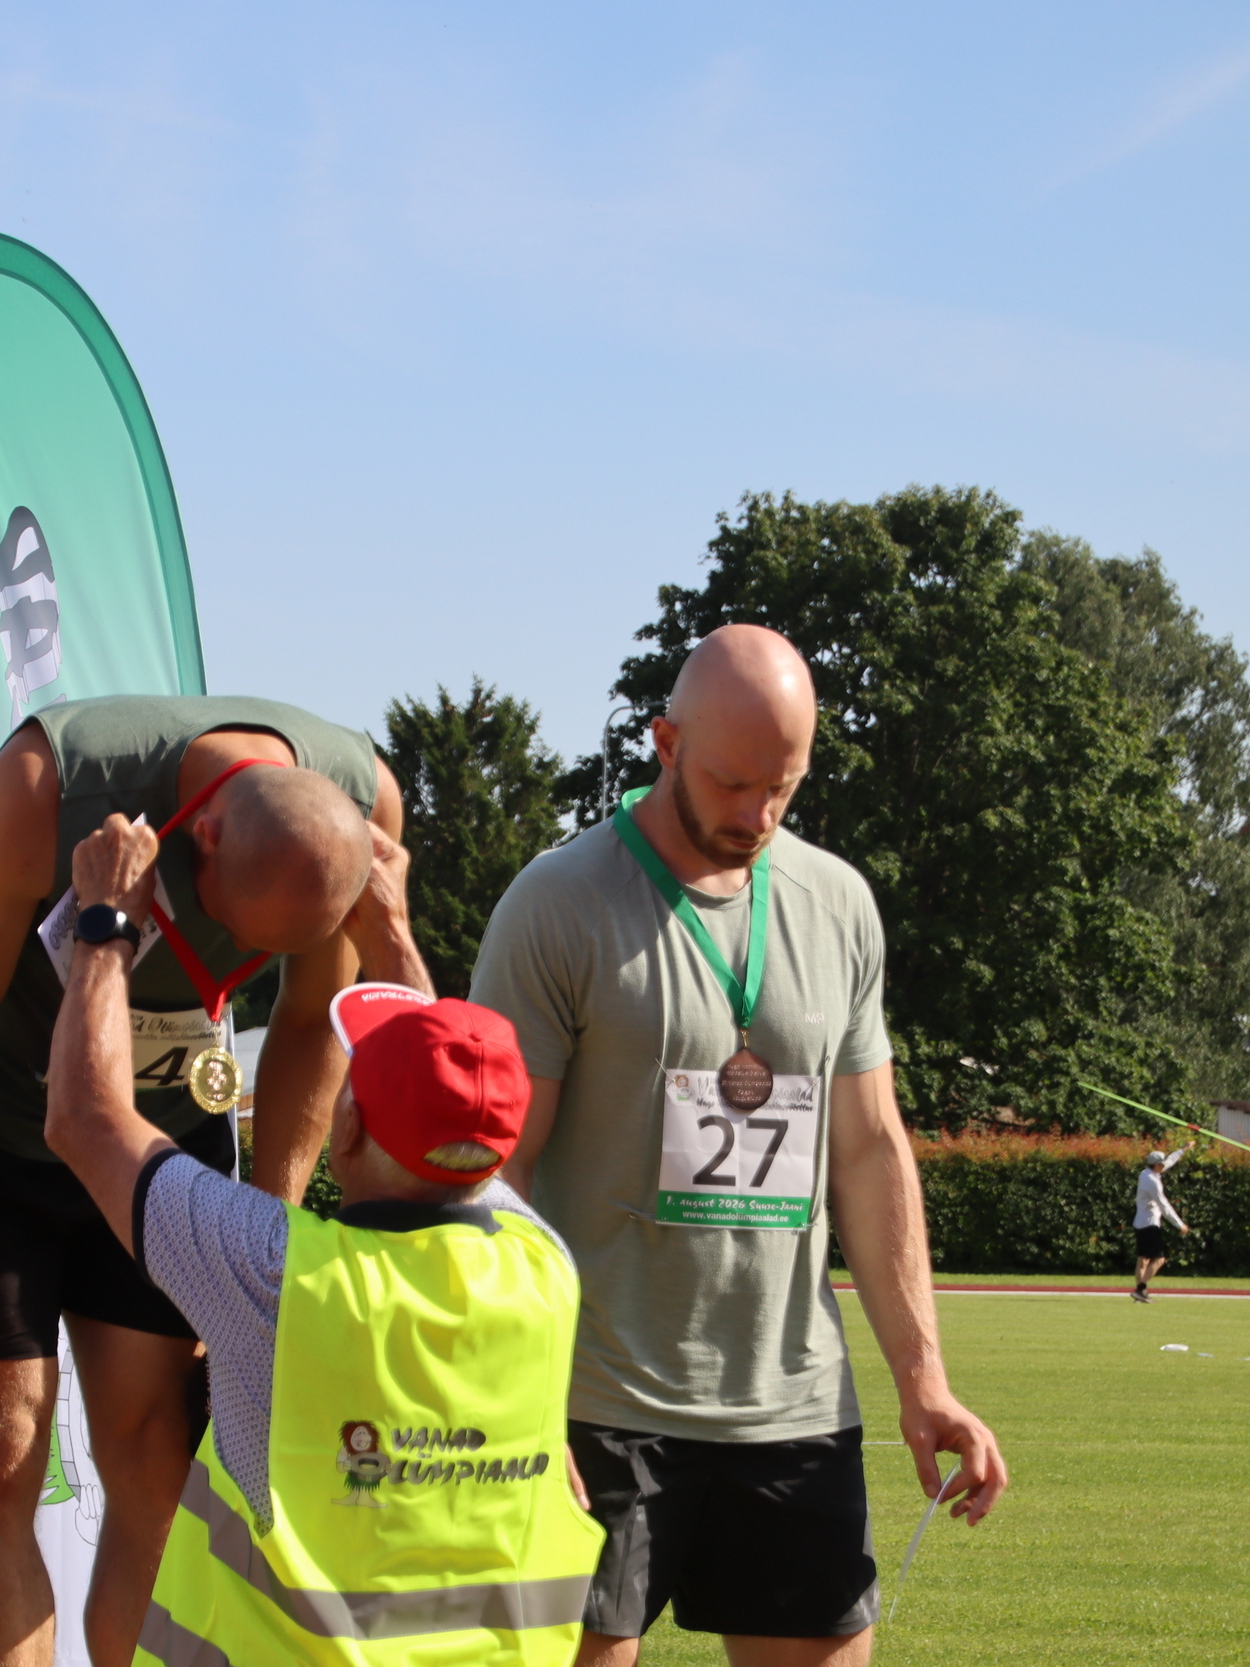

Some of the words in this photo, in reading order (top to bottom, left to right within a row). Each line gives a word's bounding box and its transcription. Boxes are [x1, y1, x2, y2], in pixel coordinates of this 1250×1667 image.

[804, 1012, 825, 1024] MP
[135, 1046, 189, 1086] 4
[692, 1115, 789, 1188] 27
[679, 1199, 715, 1209] august
[718, 1198, 746, 1210] 2026
[748, 1200, 804, 1212] Suure-Jaani
[682, 1211, 789, 1223] www.vanadolümpiaalad.ee
[391, 1427, 486, 1453] VANAD
